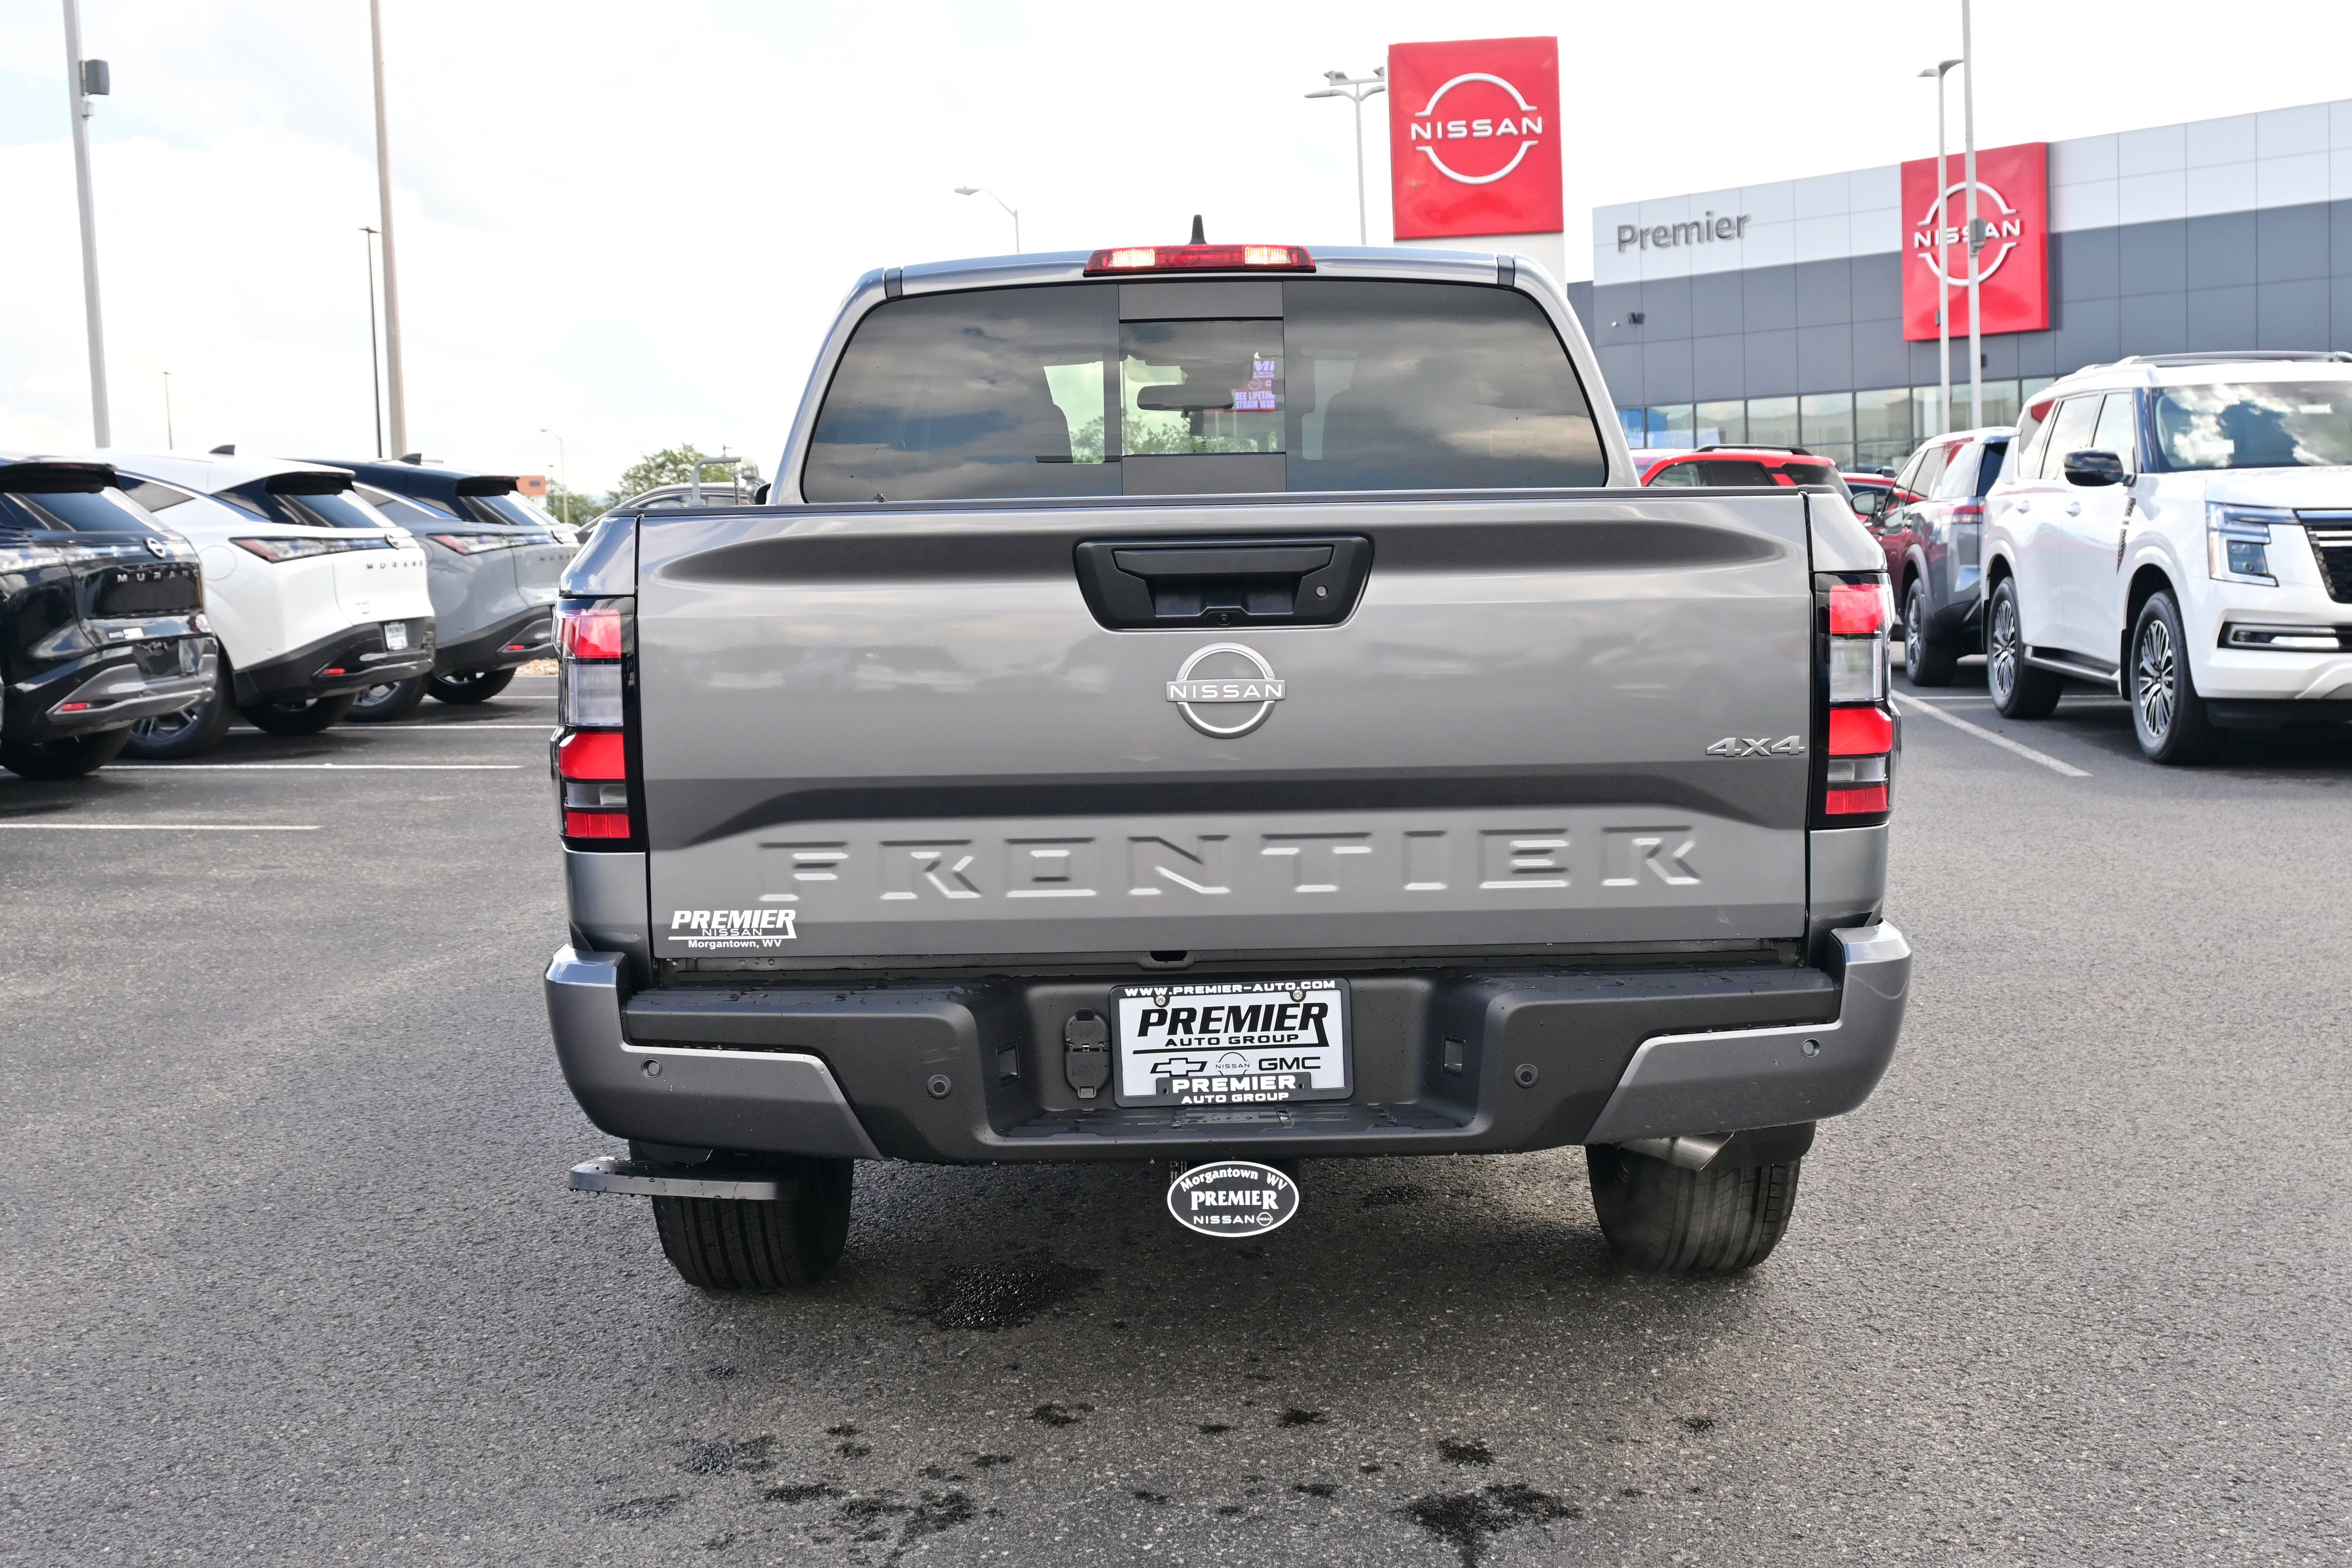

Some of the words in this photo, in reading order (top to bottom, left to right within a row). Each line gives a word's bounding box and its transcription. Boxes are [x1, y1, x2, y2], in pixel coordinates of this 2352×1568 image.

[1411, 116, 1542, 141] NISSAN
[1618, 210, 1750, 252] Premier
[1259, 400, 1275, 408] WAR
[366, 560, 423, 569] MURANO
[117, 569, 199, 583] MURANO
[1170, 683, 1282, 698] NISSAN
[758, 825, 1700, 902] FRONTIER
[671, 909, 797, 934] PREMIER
[702, 928, 762, 936] NISSAN
[688, 940, 759, 950] Morgantown,
[762, 939, 781, 947] WV
[1124, 980, 1335, 997] WWW.PREMIER-AUTO.COM
[1137, 1002, 1329, 1043] PREMIER
[1165, 1037, 1220, 1047] AUTO
[1228, 1034, 1299, 1044] GROUP
[1258, 1056, 1321, 1071] GMC
[1172, 1075, 1296, 1094] PREMIER
[1181, 1095, 1227, 1104] AUTO
[1231, 1092, 1289, 1102] GROUP
[1180, 1167, 1259, 1192] Morgantown
[1266, 1172, 1288, 1190] WV
[1190, 1190, 1279, 1211] PREMIER
[1193, 1215, 1255, 1225] NISSAN
